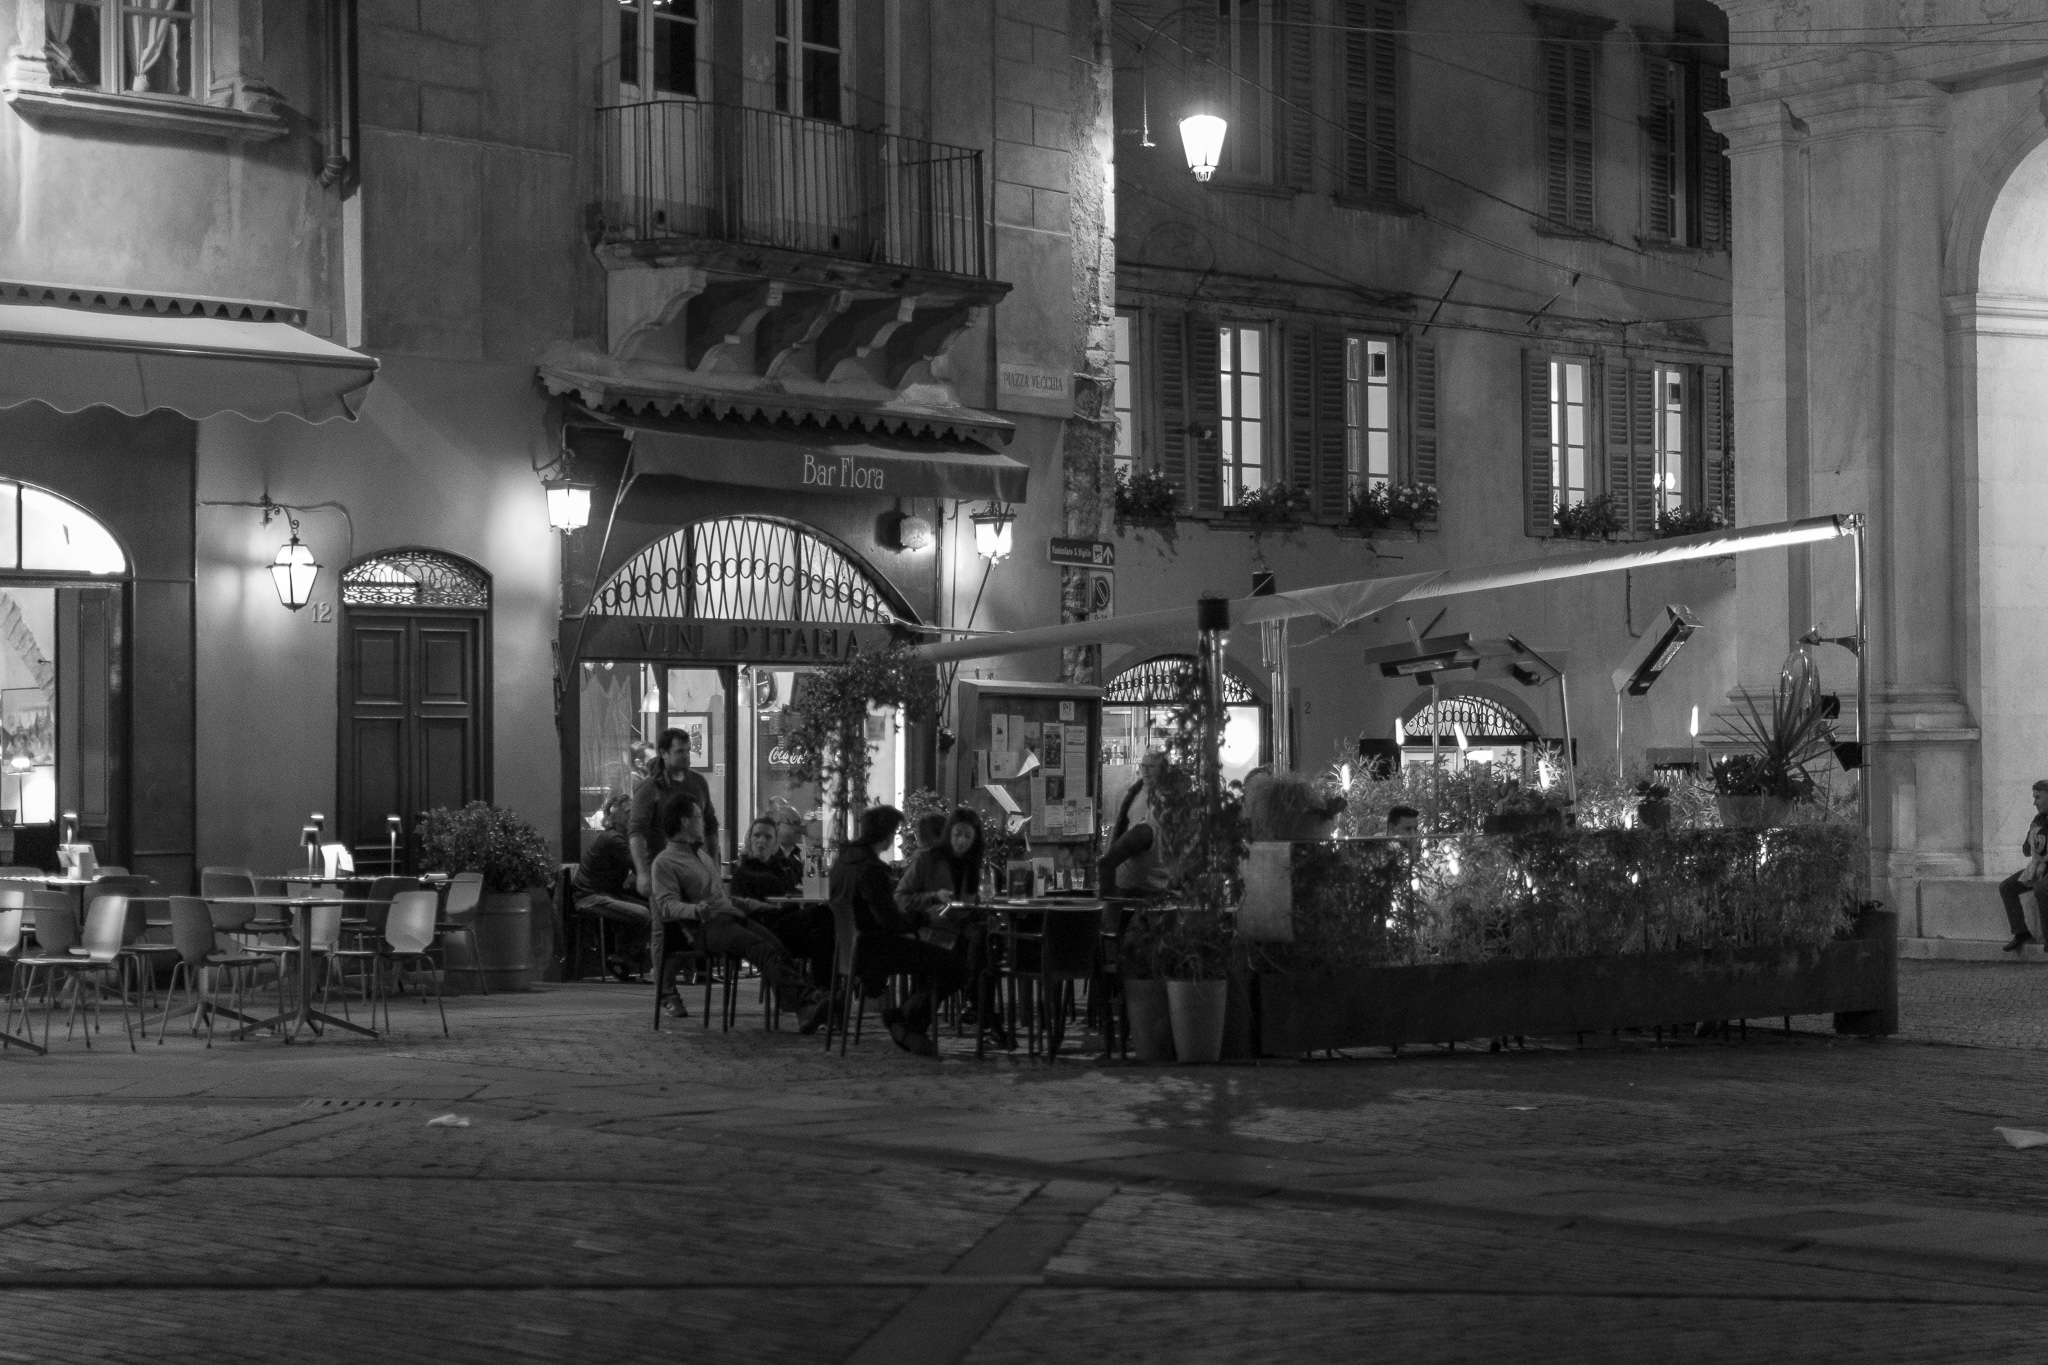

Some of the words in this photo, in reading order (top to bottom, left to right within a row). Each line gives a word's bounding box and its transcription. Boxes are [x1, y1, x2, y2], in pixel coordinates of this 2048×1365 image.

[1003, 372, 1029, 388] PIAZZA
[1031, 375, 1063, 391] VECCHIA
[802, 454, 836, 486] Bar
[840, 455, 884, 490] Flora
[312, 602, 332, 624] 12
[637, 623, 705, 653] VINI
[731, 625, 860, 660] D'ITALIA
[1304, 701, 1311, 714] 2
